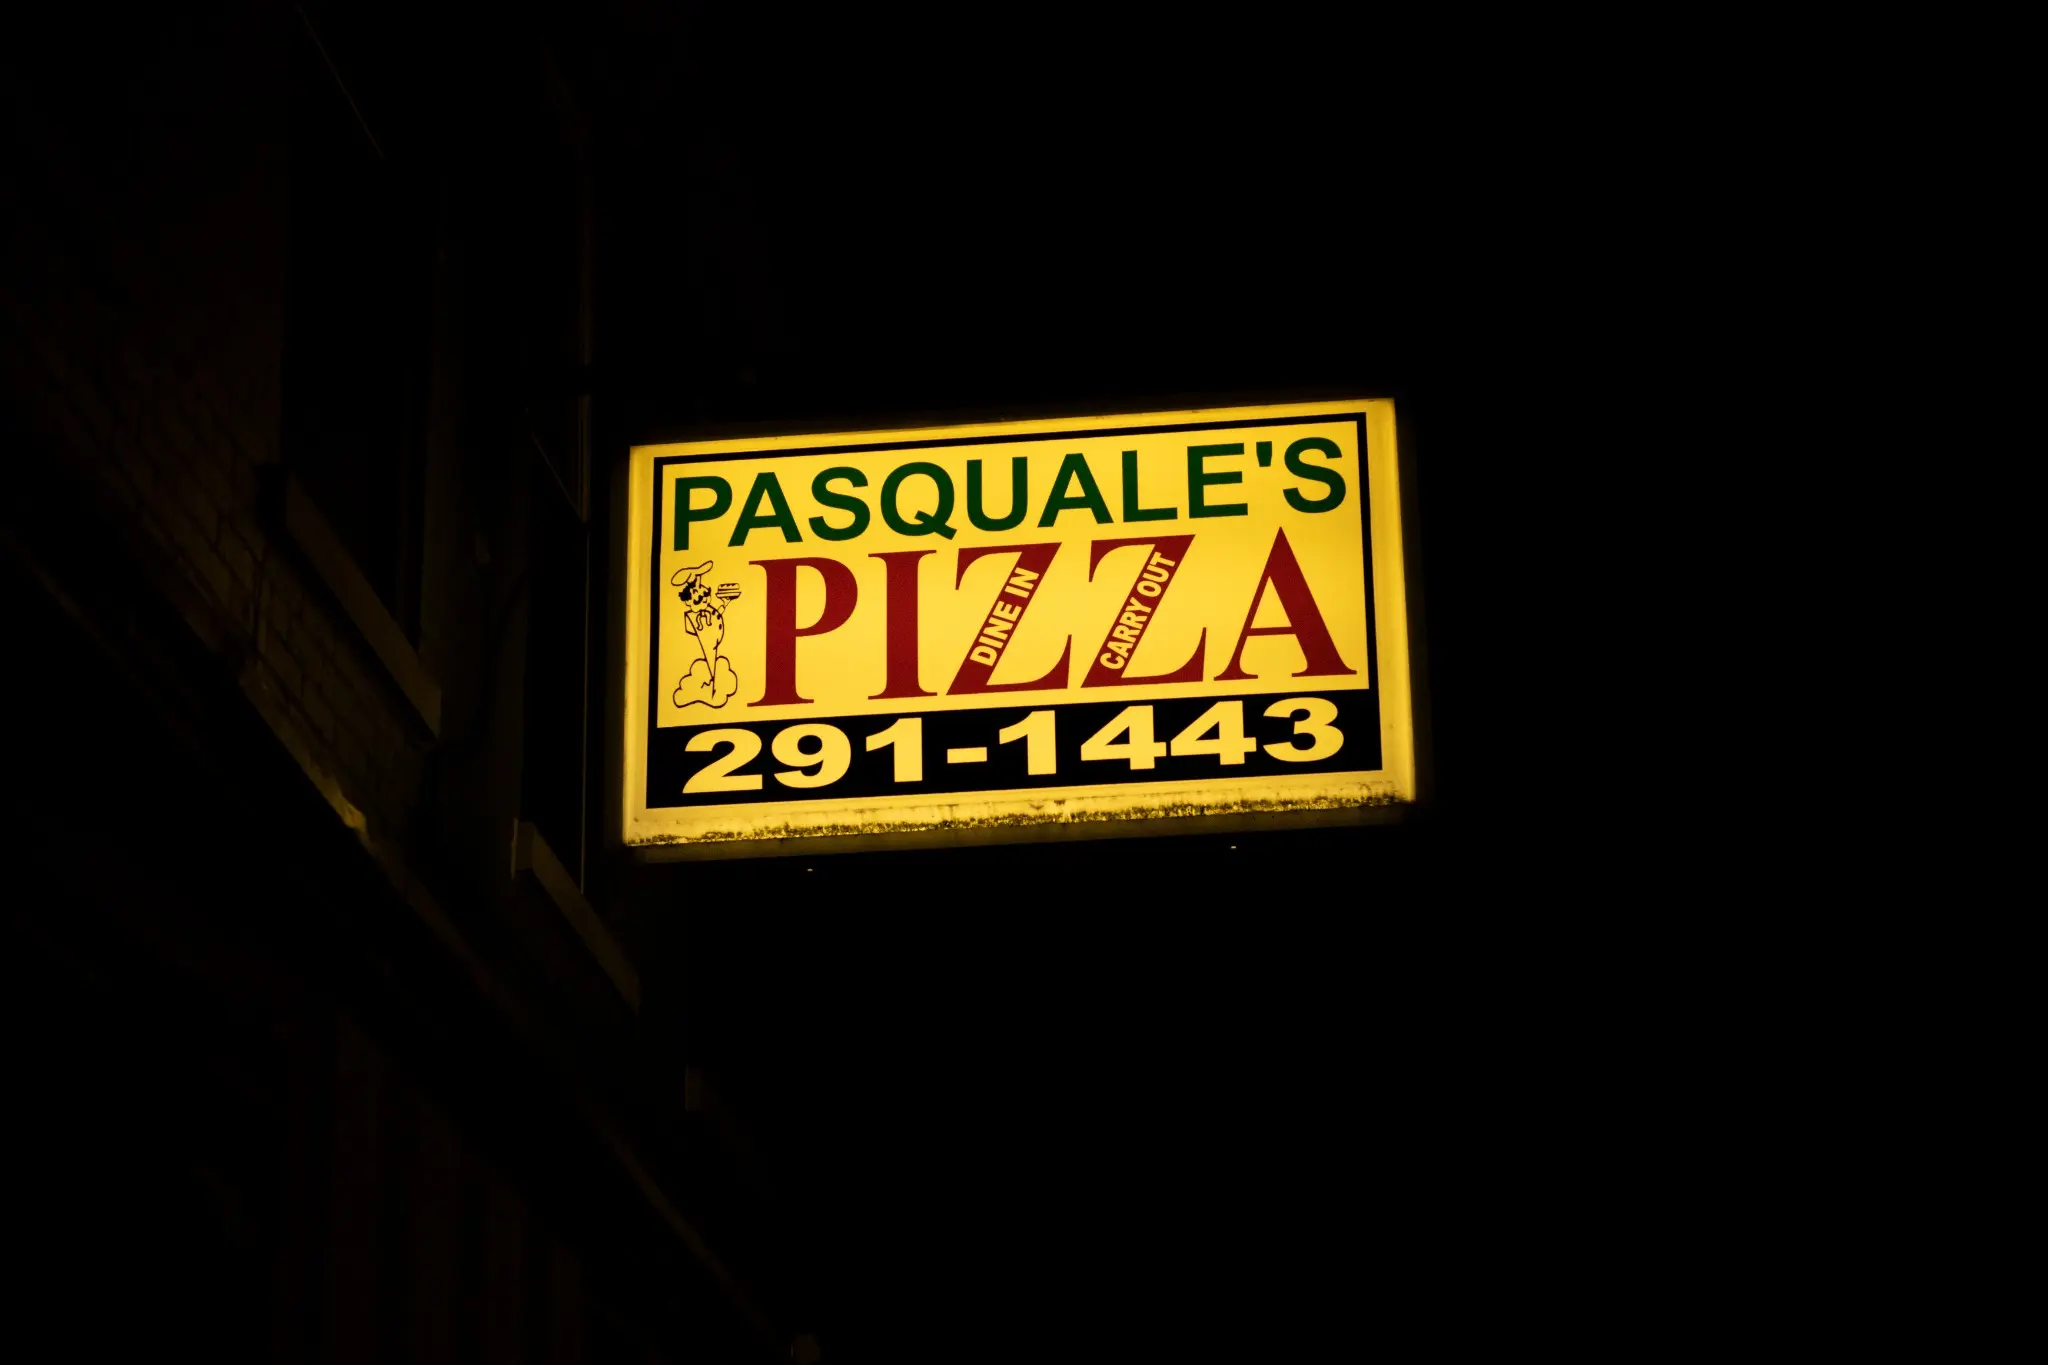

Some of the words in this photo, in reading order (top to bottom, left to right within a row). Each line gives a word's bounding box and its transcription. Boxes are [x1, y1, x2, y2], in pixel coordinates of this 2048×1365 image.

[672, 436, 1347, 551] PASQUALE'S
[747, 526, 1358, 707] PIZZA
[969, 601, 1022, 667] DINE
[1004, 567, 1040, 598] IN
[1100, 597, 1152, 670] CARRY
[1136, 551, 1176, 598] OUT
[682, 697, 1345, 793] 291-1443
